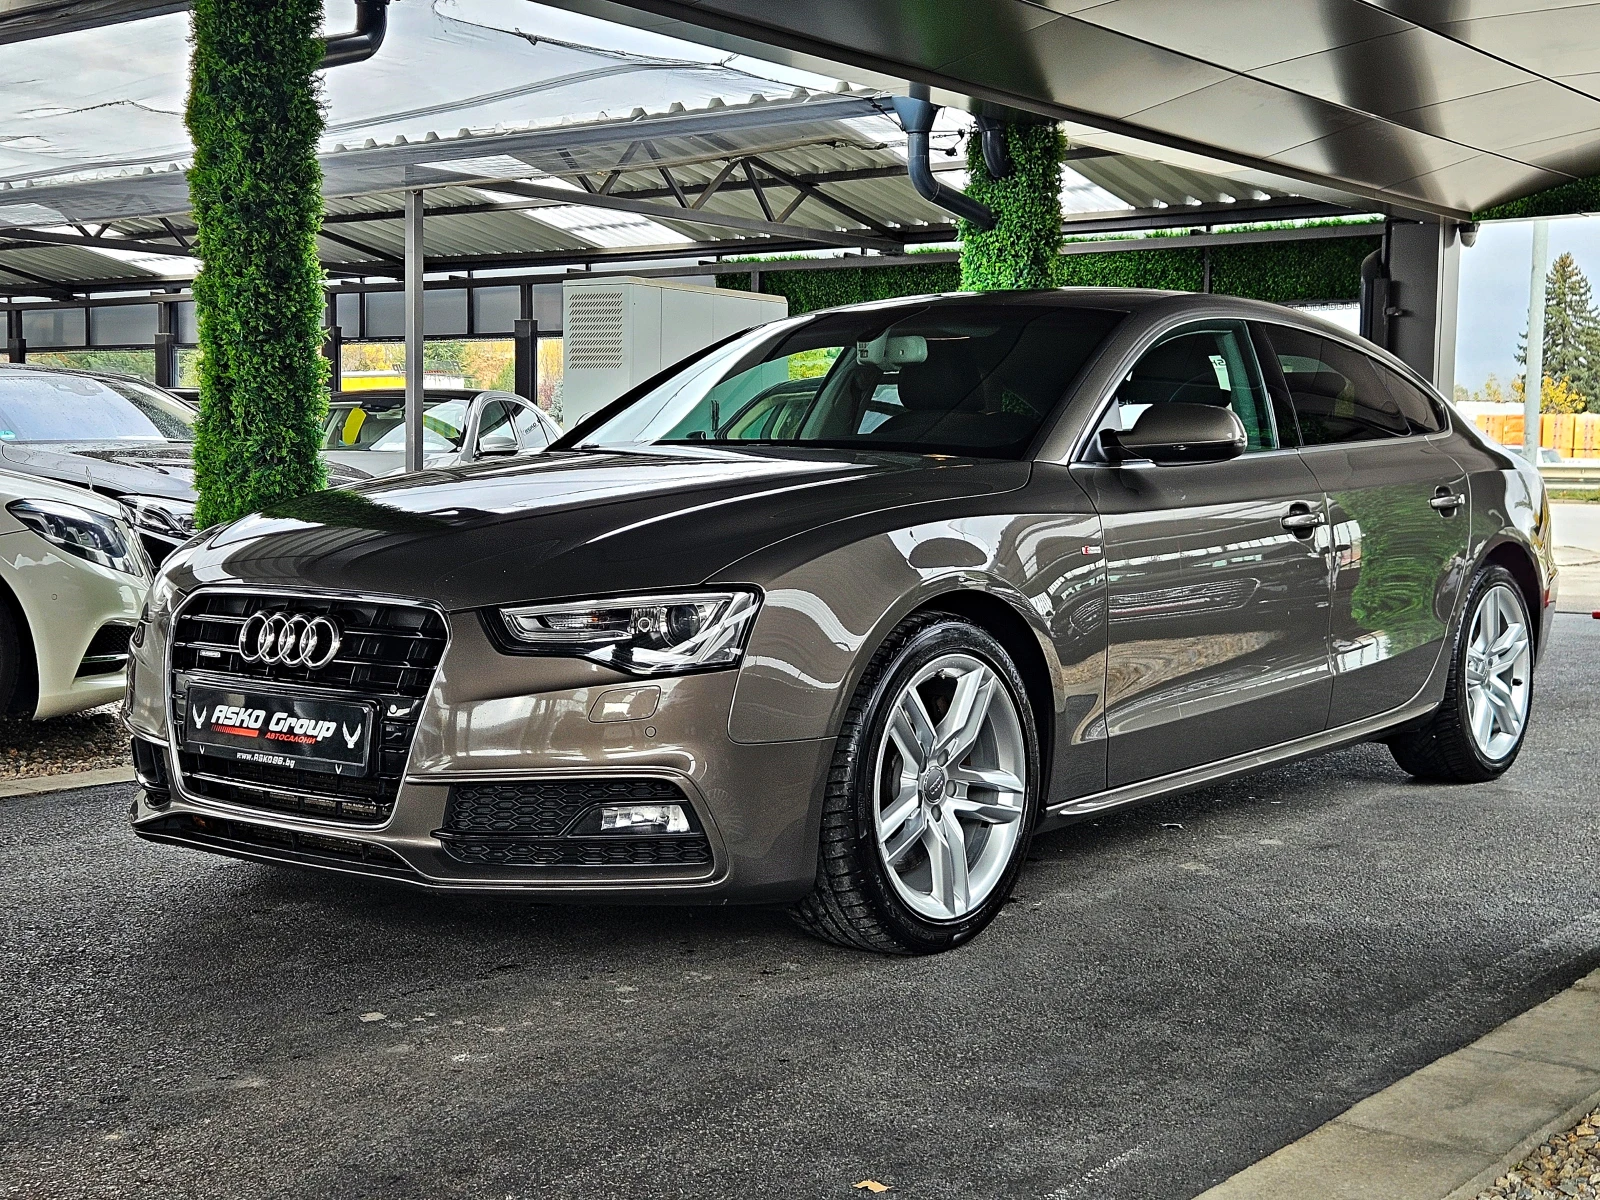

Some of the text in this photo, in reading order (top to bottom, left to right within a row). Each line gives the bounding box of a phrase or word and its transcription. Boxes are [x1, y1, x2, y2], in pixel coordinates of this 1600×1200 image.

[210, 705, 337, 741] ASKO Group
[264, 731, 317, 745] АВТОСАЛОНИ
